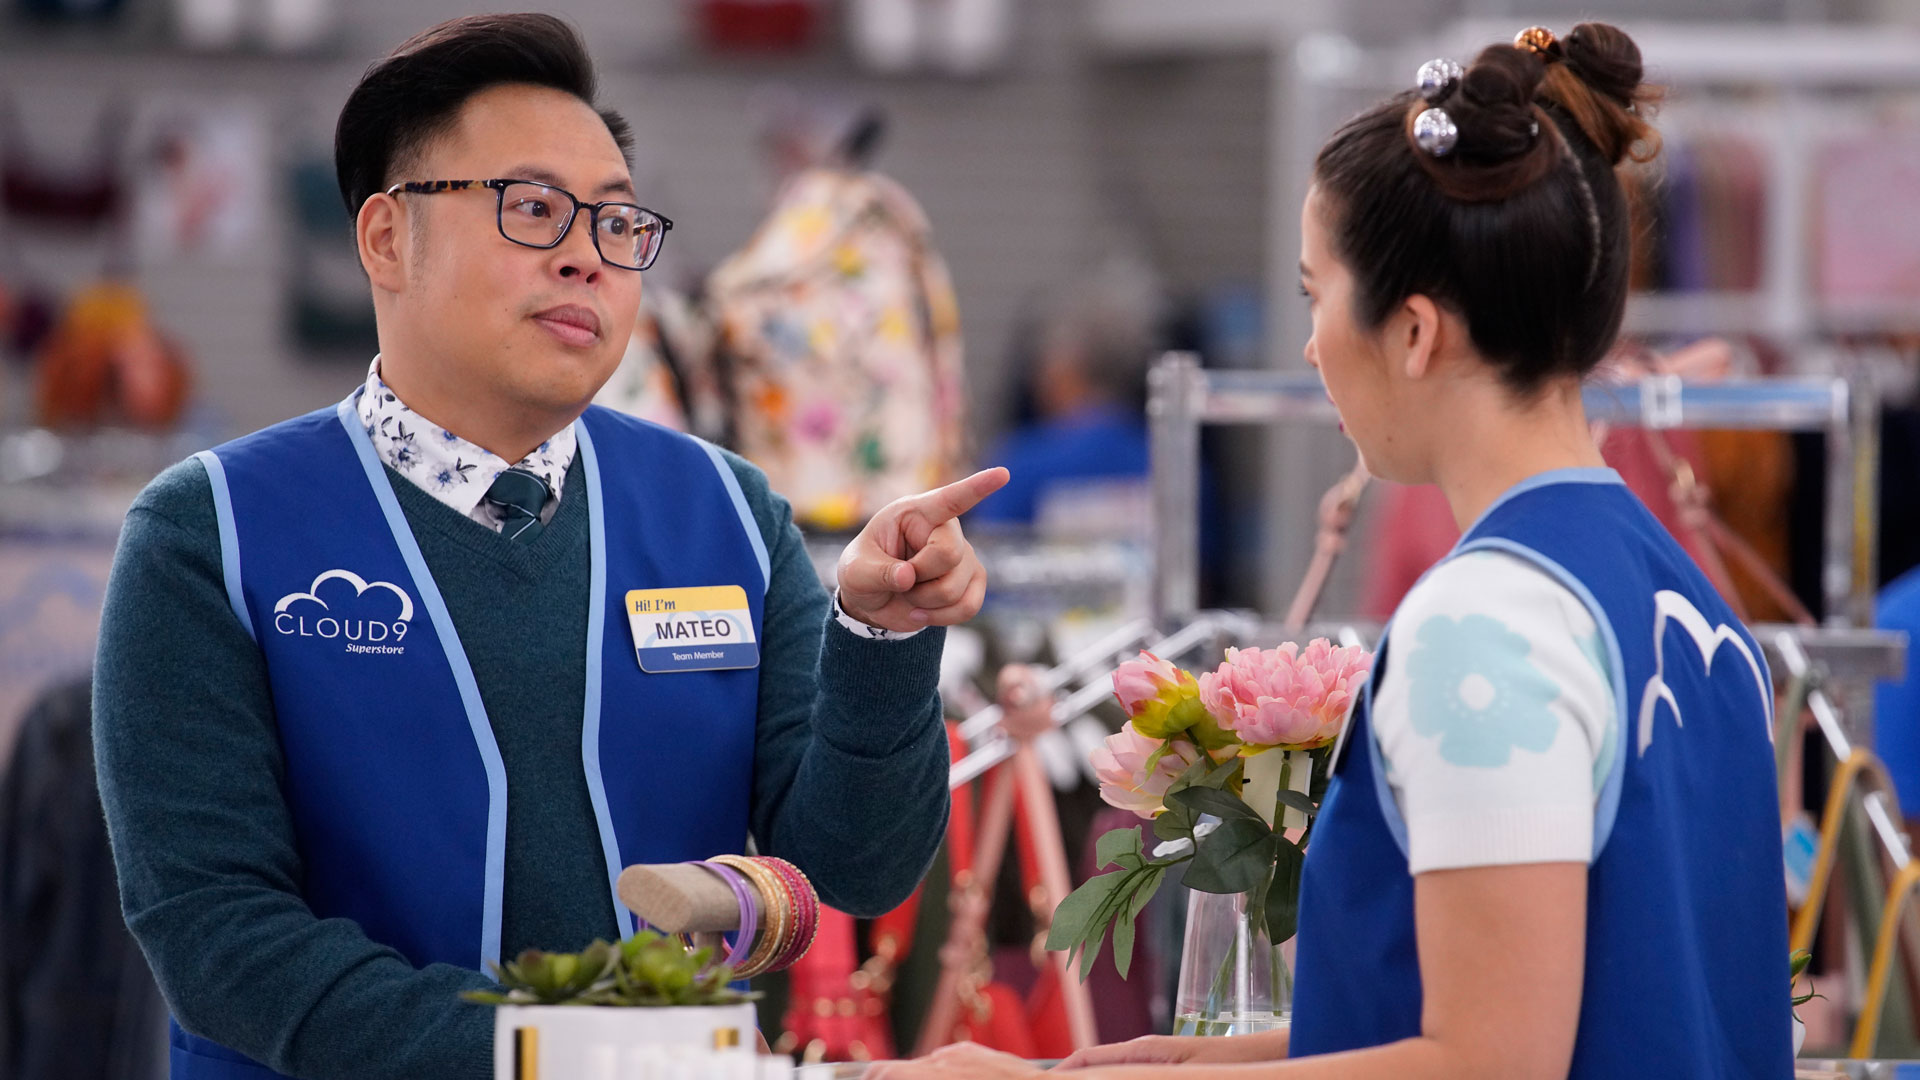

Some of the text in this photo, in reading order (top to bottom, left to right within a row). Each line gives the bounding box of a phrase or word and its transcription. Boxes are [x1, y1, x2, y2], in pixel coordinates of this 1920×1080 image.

[635, 599, 676, 612] Hi! I'm
[275, 613, 408, 641] CLOUD9
[655, 619, 731, 640] MATEO
[345, 643, 405, 655] Superstore
[672, 650, 724, 661] Team Member
